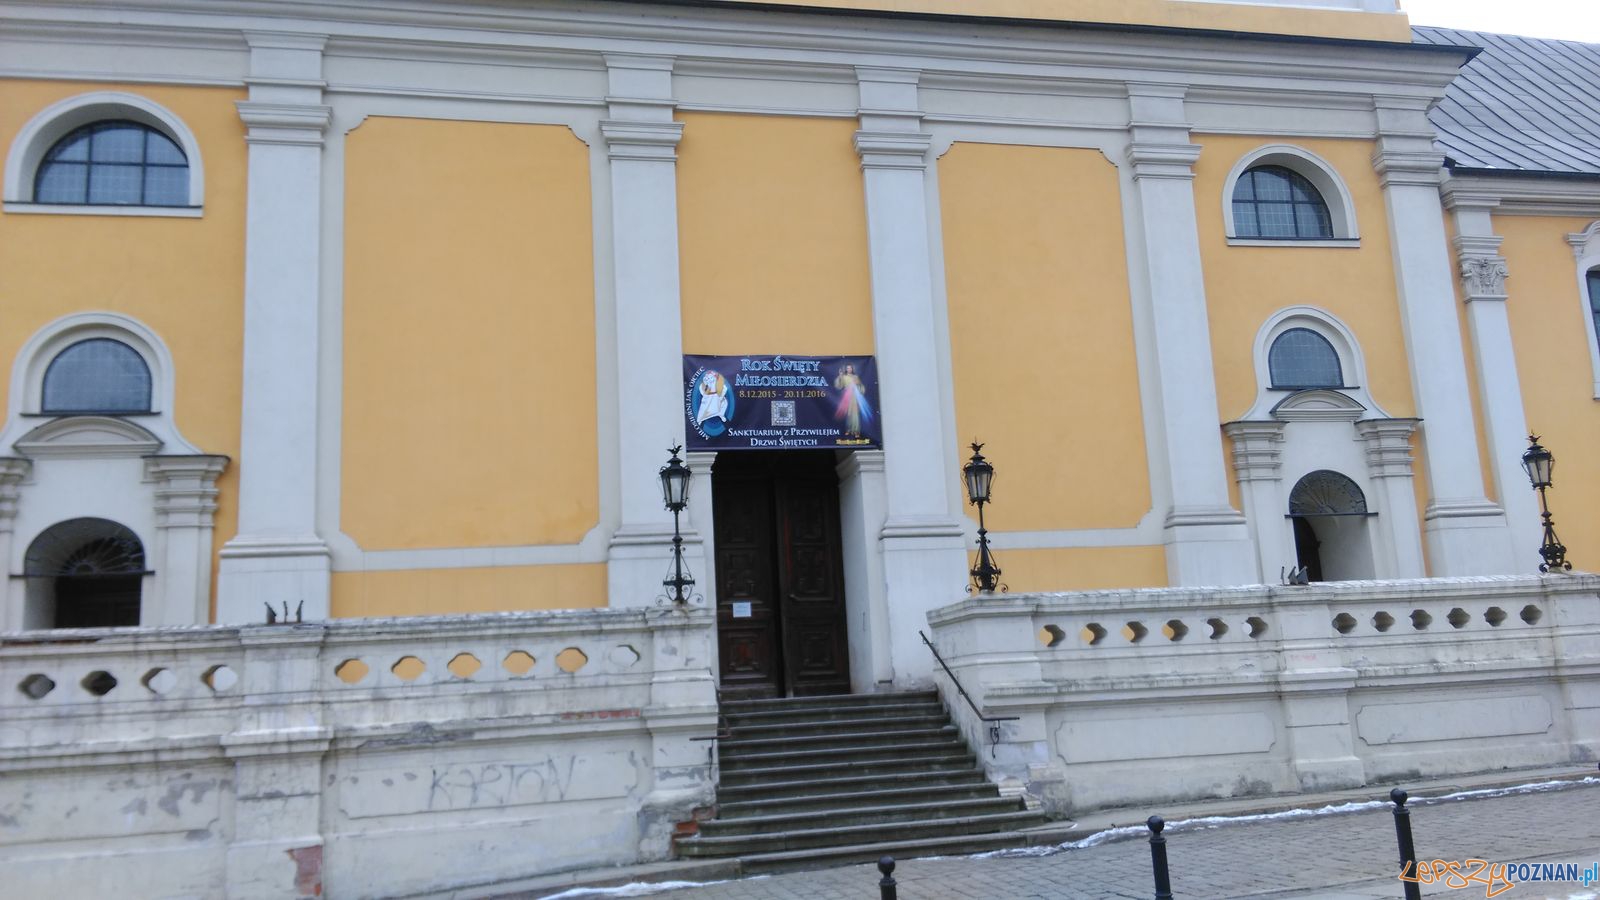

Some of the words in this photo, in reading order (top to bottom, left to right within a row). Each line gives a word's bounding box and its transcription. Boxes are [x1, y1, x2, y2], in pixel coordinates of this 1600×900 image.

[741, 359, 774, 372] ROK
[773, 356, 820, 373] ŚWIĘTY
[735, 373, 829, 387] MIŁOSIERDZIA
[739, 390, 777, 398] 8.12.2015
[784, 390, 826, 398] 20.11.2016
[728, 427, 783, 437] SANKTUARIUM
[790, 427, 840, 437] PRZYWILEJEM
[750, 438, 778, 447] DRZWI
[778, 436, 818, 447] ŚWIĘTYCH
